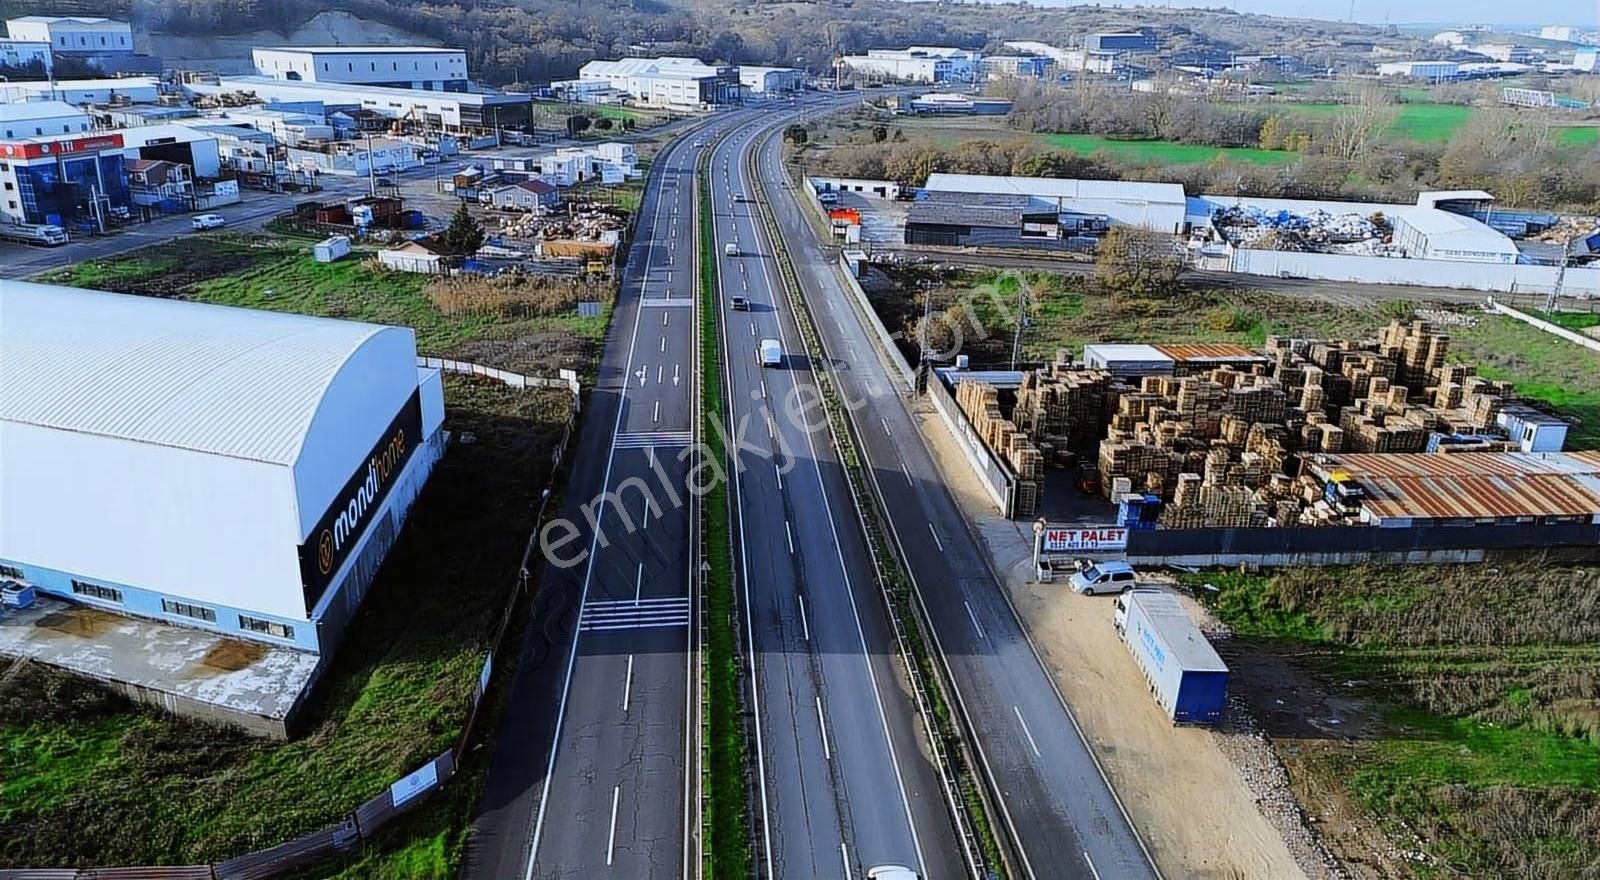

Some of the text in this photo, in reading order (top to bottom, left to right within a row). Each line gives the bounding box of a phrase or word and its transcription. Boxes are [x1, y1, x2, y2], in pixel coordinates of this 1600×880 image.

[334, 430, 405, 551] mondihome
[1049, 530, 1125, 541] NET PALET
